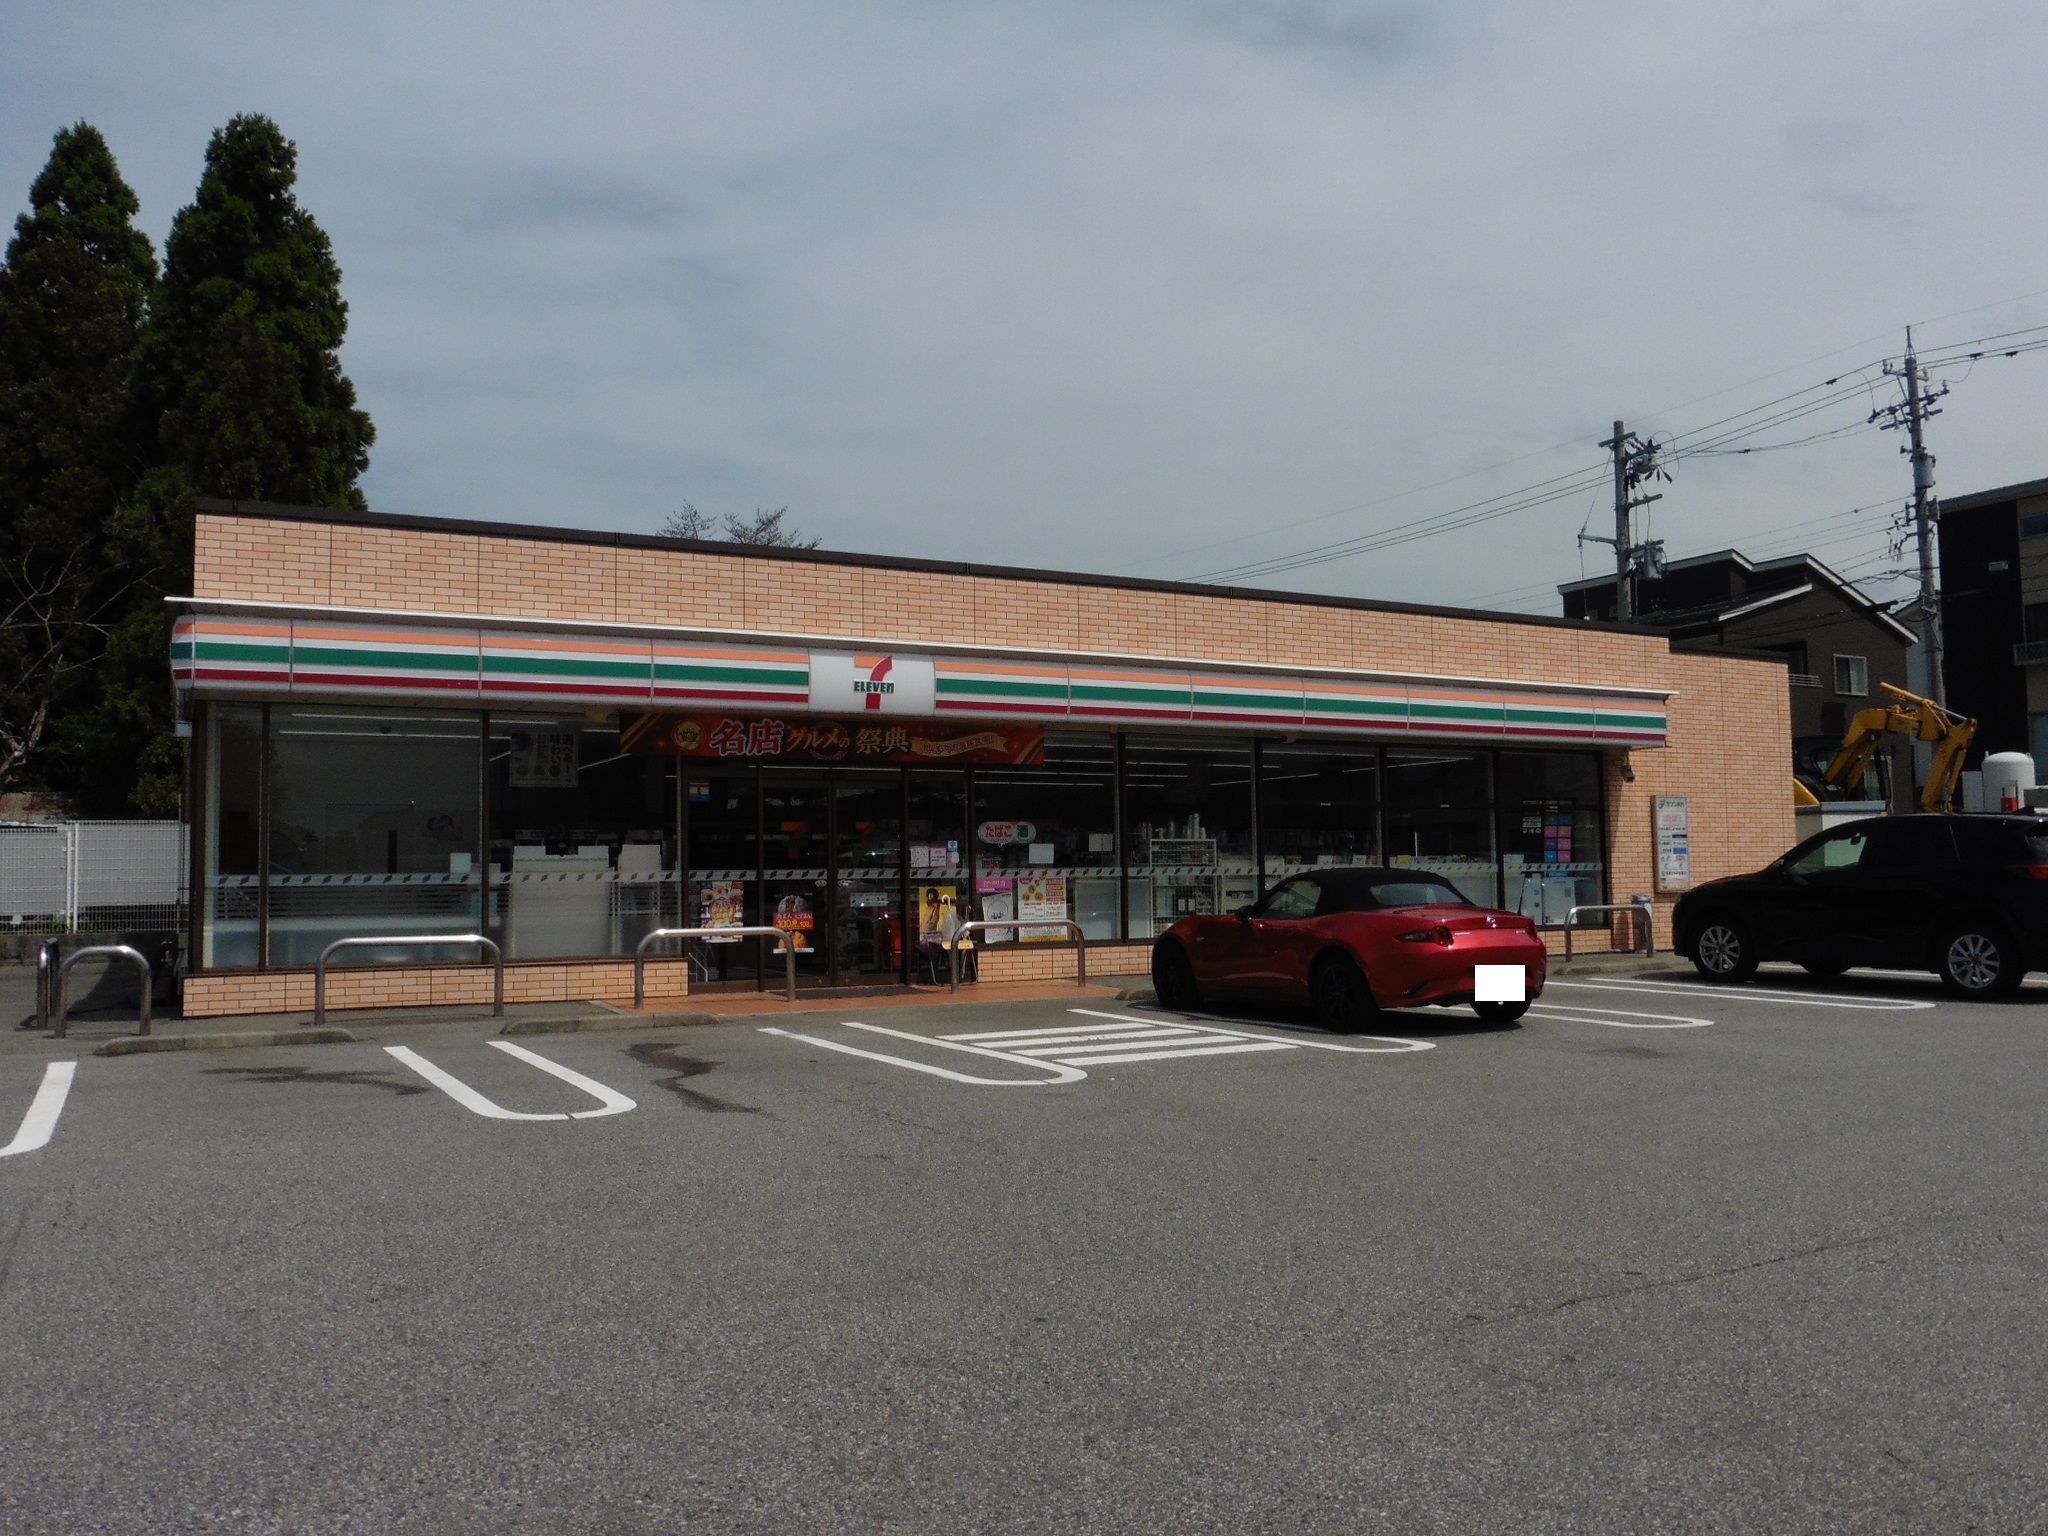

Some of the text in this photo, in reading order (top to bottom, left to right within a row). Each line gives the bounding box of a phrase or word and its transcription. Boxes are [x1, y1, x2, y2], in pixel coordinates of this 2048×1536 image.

[985, 824, 1029, 838] たばこ 酒
